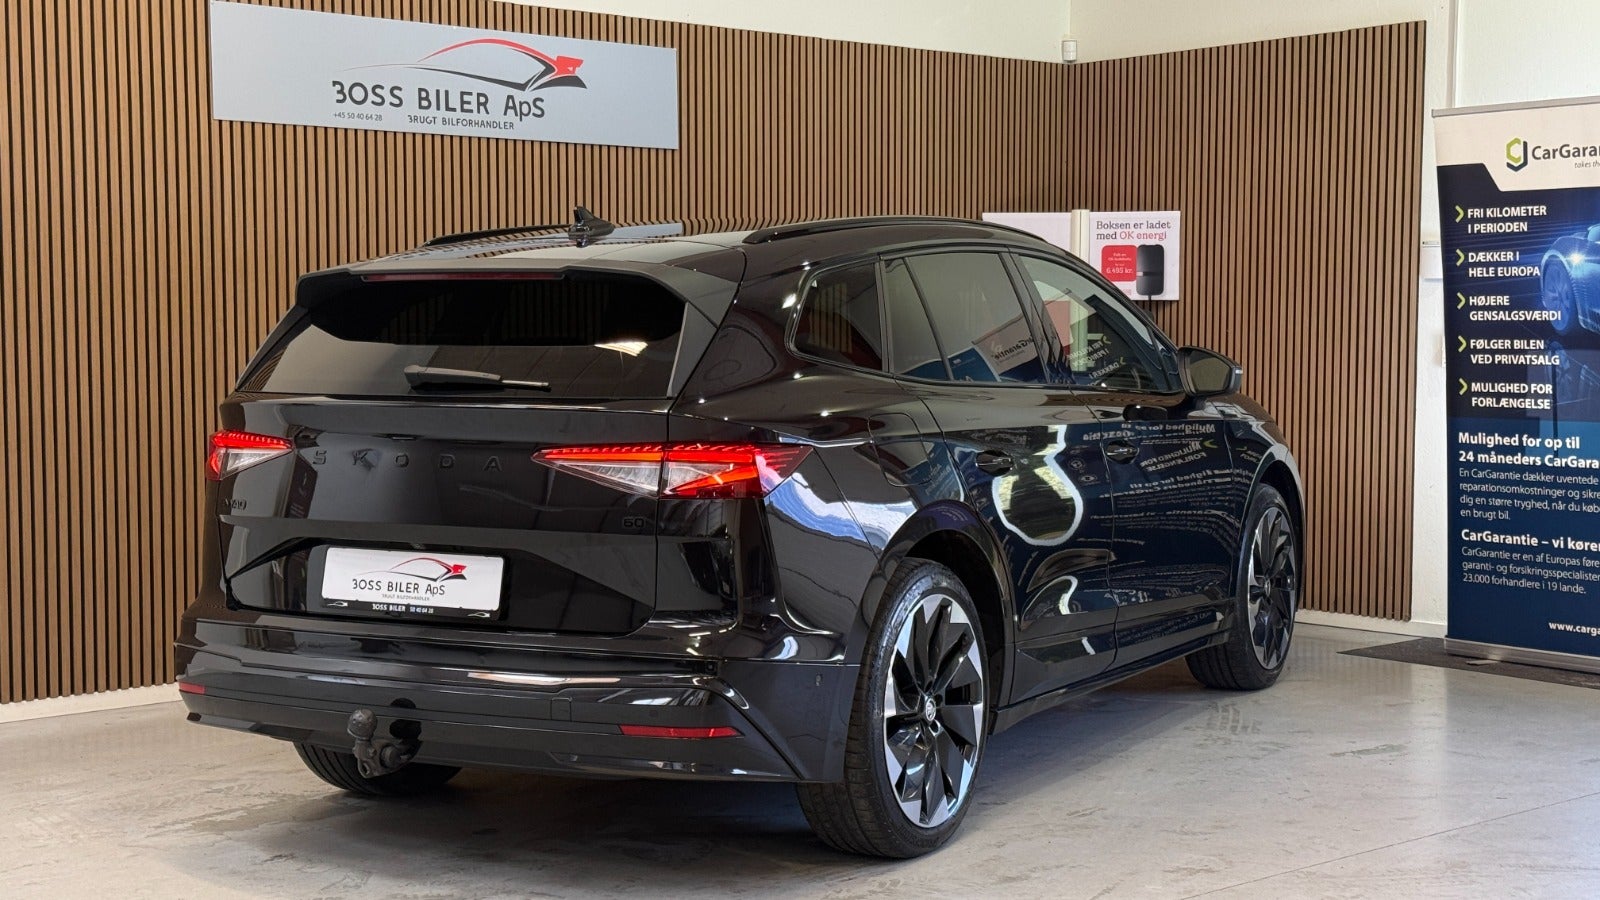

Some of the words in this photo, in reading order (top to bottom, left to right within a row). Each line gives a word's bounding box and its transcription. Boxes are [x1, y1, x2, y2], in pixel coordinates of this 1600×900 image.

[332, 80, 403, 108] BOSS
[417, 87, 490, 115] BILER
[503, 94, 545, 121] ApS
[374, 114, 383, 122] 28
[407, 115, 437, 125] BRUGT
[441, 117, 514, 130] BILFORHANDLER
[1531, 144, 1600, 160] CarGara
[1467, 208, 1484, 219] FRI
[1486, 205, 1547, 218] KILOMETER
[1096, 220, 1131, 230] Boksen
[1133, 222, 1144, 230] er
[1145, 220, 1171, 229] ladet
[1467, 224, 1471, 233] I
[1473, 222, 1528, 233] PERIODEN
[1096, 231, 1117, 240] med
[1119, 231, 1135, 240] OK
[1136, 231, 1167, 242] energi
[1468, 252, 1514, 263] DÆKKER
[1516, 252, 1519, 261] I
[1468, 267, 1495, 277] HELE
[1498, 266, 1541, 277] EUROPA
[1469, 295, 1510, 306] HØJERE
[1469, 310, 1562, 321] GENSALGSVÆRDI
[1470, 339, 1512, 350] FØLGER
[1514, 339, 1544, 350] BILEN
[1470, 354, 1492, 364] VED
[1494, 354, 1560, 365] PRIVATSALG
[1471, 382, 1528, 394] MULIGHED
[1531, 383, 1553, 394] FOR
[1471, 397, 1551, 410] FORLÆNGELSE
[1458, 432, 1519, 448] Mulighed
[1522, 435, 1541, 447] for
[1544, 437, 1562, 450] op
[1565, 436, 1580, 449] til
[1459, 451, 1474, 462] 24
[1477, 451, 1542, 466] måneders
[1544, 455, 1599, 469] CarGara
[1459, 468, 1469, 477] En
[1471, 469, 1521, 480] CarGarantie
[1522, 472, 1554, 482] dækker
[1556, 475, 1599, 485] uventede
[1459, 482, 1565, 498] reparationsomkostninger
[1567, 491, 1580, 500] og
[1459, 495, 1473, 506] dig
[1488, 497, 1512, 506] større
[1514, 499, 1550, 511] tryghed,
[1552, 501, 1566, 510] når
[1568, 503, 1580, 511] du
[1582, 503, 1600, 513] køb
[1473, 509, 1496, 520] brugt
[1498, 510, 1511, 520] bil.
[623, 516, 646, 528] 60
[1461, 529, 1538, 546] CarGarantie
[1552, 537, 1564, 549] vi
[1461, 546, 1510, 559] CarGarantie
[1523, 553, 1534, 561] en
[1535, 553, 1544, 562] af
[1546, 554, 1580, 567] Europas
[1462, 561, 1494, 571] garanti-
[1496, 565, 1508, 573] og
[352, 578, 382, 591] BOSS
[387, 581, 420, 594] BILER
[425, 584, 446, 597] ApS
[1463, 573, 1490, 584] 23.000
[1491, 575, 1540, 589] forhandlere
[1547, 581, 1558, 591] 19
[1559, 582, 1587, 594] lande.
[372, 603, 387, 611] BOSS
[388, 604, 406, 612] BILER
